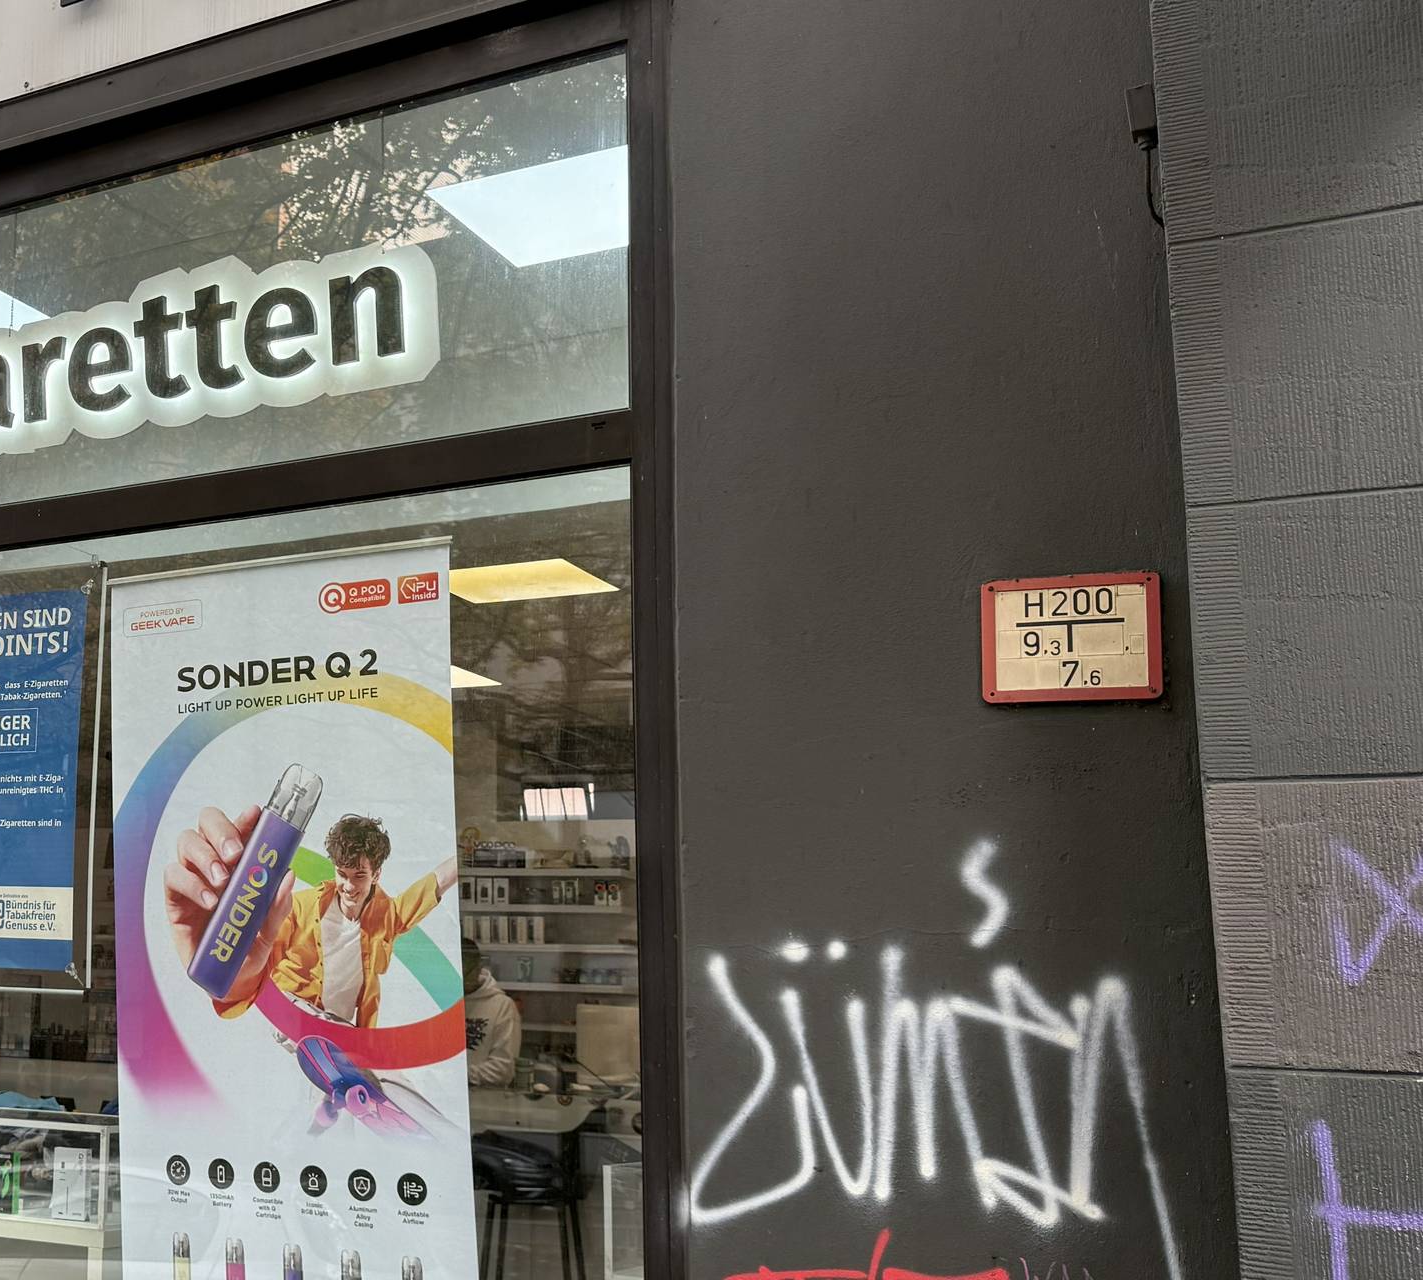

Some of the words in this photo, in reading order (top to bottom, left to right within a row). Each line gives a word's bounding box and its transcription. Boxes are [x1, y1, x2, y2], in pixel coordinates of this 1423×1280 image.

[361, 585, 385, 596] POD
[349, 594, 385, 604] Compatible
[22, 607, 72, 628] SIND
[140, 608, 174, 618] POWERED
[177, 655, 316, 692] SONDER
[325, 651, 351, 678] Q
[359, 649, 378, 676] 2
[4, 680, 21, 689] dass
[24, 678, 69, 690] E-Zigaretten
[0, 690, 63, 702] Tabak-Zigaretten.
[178, 702, 211, 714] LIGHT
[215, 699, 232, 710] UP
[236, 695, 282, 709] POWER
[286, 692, 324, 705] LIGHT
[328, 690, 345, 701] UP
[349, 687, 378, 700] LIFE
[0, 774, 23, 783] nichts
[24, 774, 37, 782] mit
[39, 785, 53, 794] THC
[56, 785, 64, 794] in
[37, 818, 53, 827] sind
[54, 818, 62, 827] in
[5, 900, 41, 910] Bündnis
[43, 900, 56, 910] für
[209, 842, 278, 963] SONDER
[6, 910, 56, 921] Tabakfreien
[5, 922, 37, 931] Genuss
[39, 922, 56, 931] e.V.
[397, 1210, 429, 1218] Adjustable
